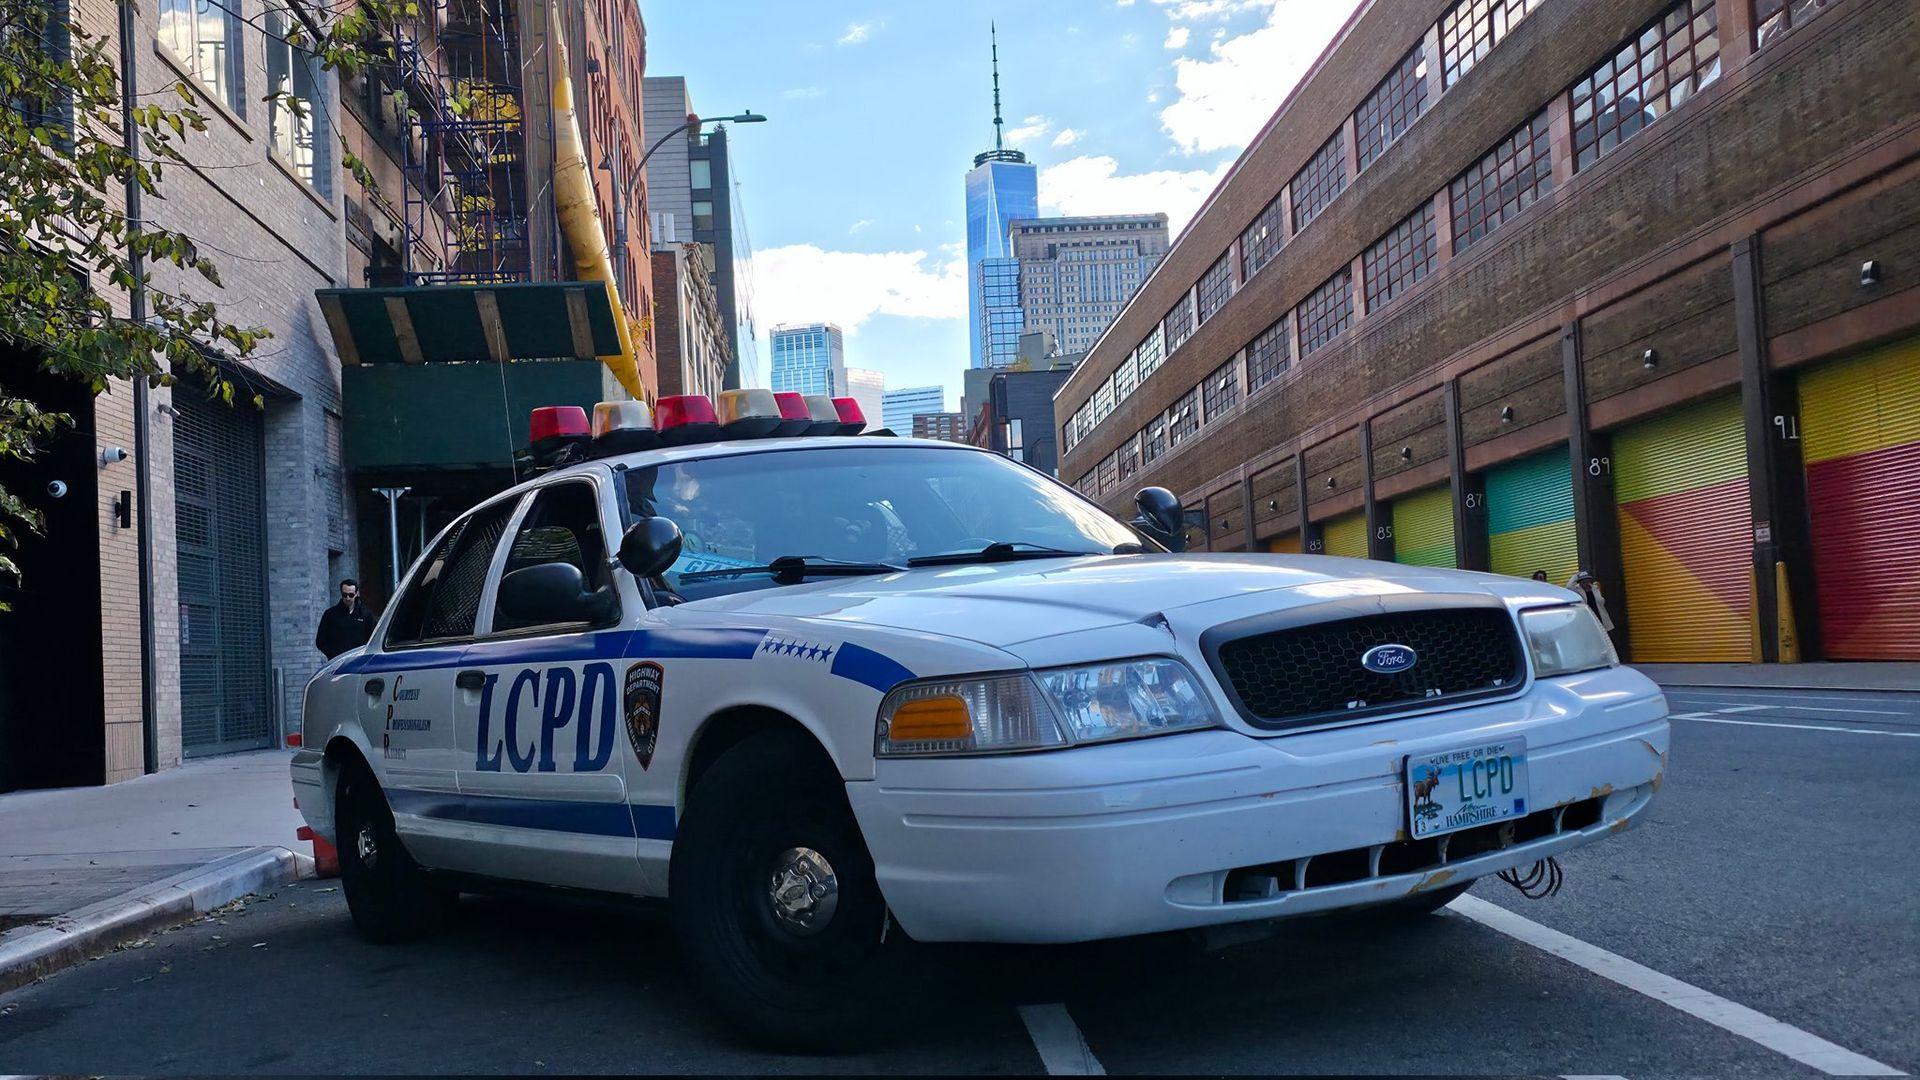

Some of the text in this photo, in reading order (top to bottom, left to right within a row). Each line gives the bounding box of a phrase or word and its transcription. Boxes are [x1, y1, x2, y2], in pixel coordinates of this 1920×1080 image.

[1774, 415, 1800, 439] 91
[1589, 457, 1610, 475] 89
[1465, 493, 1482, 508] 87
[1377, 526, 1392, 540] 85
[1309, 540, 1322, 551] 83
[1377, 649, 1406, 666] Ford
[629, 668, 660, 682] HIGHWAY
[626, 679, 661, 696] DEPARTMENT
[475, 661, 617, 773] LCPD
[1435, 745, 1498, 765] LIVE FREE OR DIE
[1457, 755, 1514, 802] LCPD
[1446, 805, 1497, 828] HAMPSHIRE
